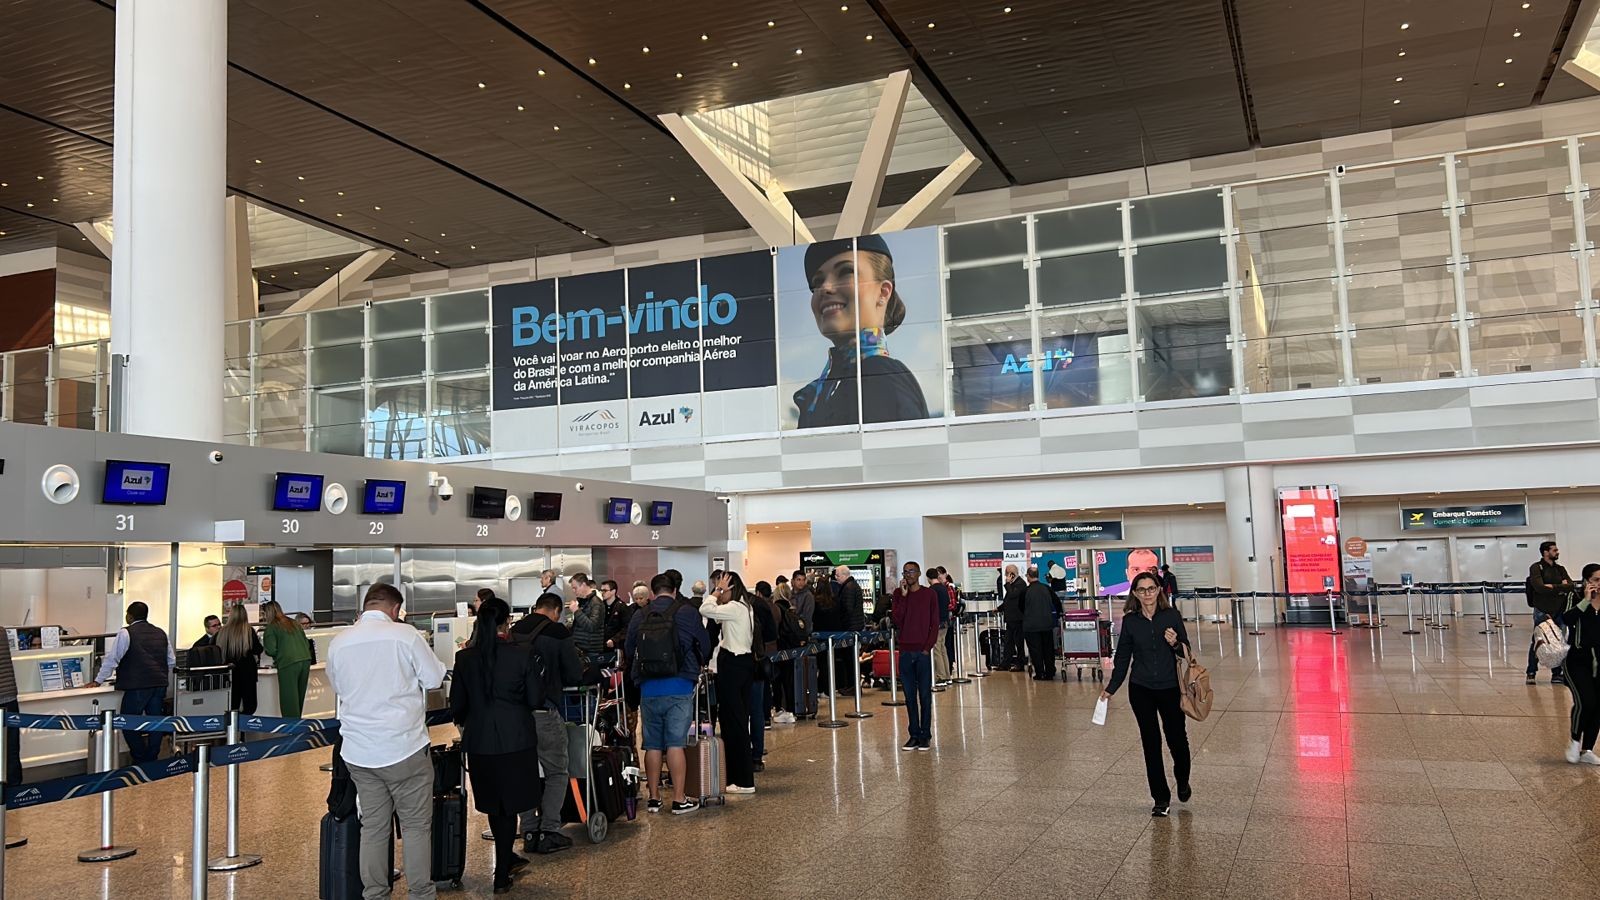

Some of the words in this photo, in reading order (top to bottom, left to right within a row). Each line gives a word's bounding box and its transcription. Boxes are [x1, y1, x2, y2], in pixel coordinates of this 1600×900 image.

[512, 284, 738, 347] Bem-vindo
[513, 354, 538, 367] Você
[540, 352, 556, 364] vai
[560, 352, 584, 362] voar
[586, 350, 599, 359] no
[661, 340, 691, 351] eleito
[692, 340, 700, 349] o
[703, 335, 742, 347] melhor
[513, 369, 526, 379] do
[560, 367, 567, 375] e
[568, 363, 592, 373] com
[593, 364, 600, 372] a
[642, 351, 700, 367] companhia
[703, 348, 737, 360] Aérea
[1001, 350, 1053, 374] Azl
[513, 381, 526, 391] da
[528, 377, 573, 390] América
[639, 408, 675, 427] Azul
[569, 422, 620, 432] VIRACOPOS
[123, 475, 143, 484] Azul
[1466, 509, 1502, 517] Doméstico
[115, 514, 135, 531] 31
[281, 518, 299, 534] 30
[369, 521, 384, 535] 29
[476, 525, 489, 537] 28
[535, 526, 546, 538] 27
[610, 528, 619, 539] 26
[651, 530, 660, 540] 25
[1047, 526, 1073, 534] Embarque
